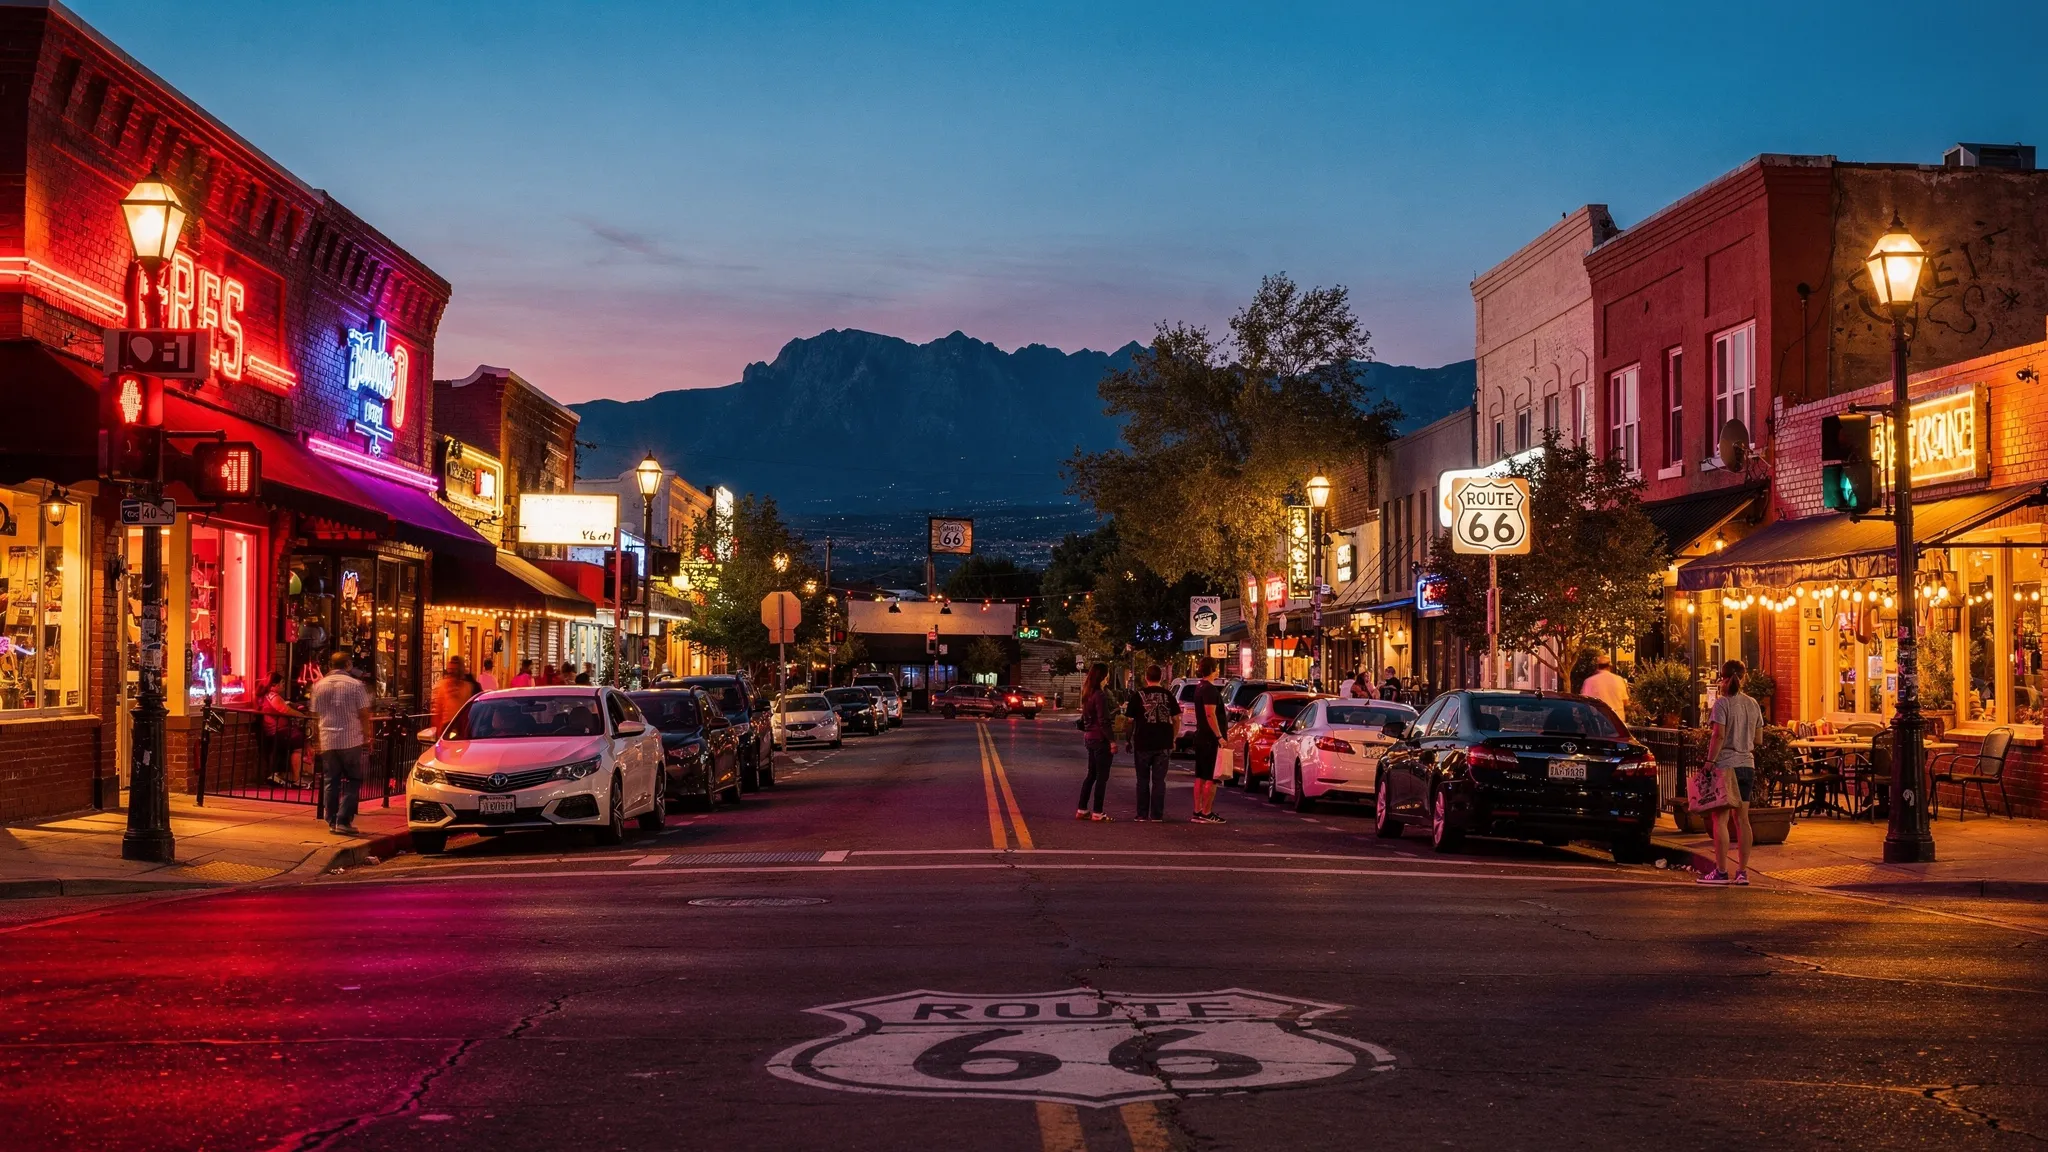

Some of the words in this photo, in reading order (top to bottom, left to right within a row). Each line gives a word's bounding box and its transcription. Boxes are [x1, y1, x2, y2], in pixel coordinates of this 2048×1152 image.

[1467, 491, 1514, 506] ROUTE
[1468, 511, 1515, 543] 66
[943, 532, 961, 545] 66
[912, 1002, 1233, 1020] ROUTE
[912, 1028, 1263, 1082] 66
